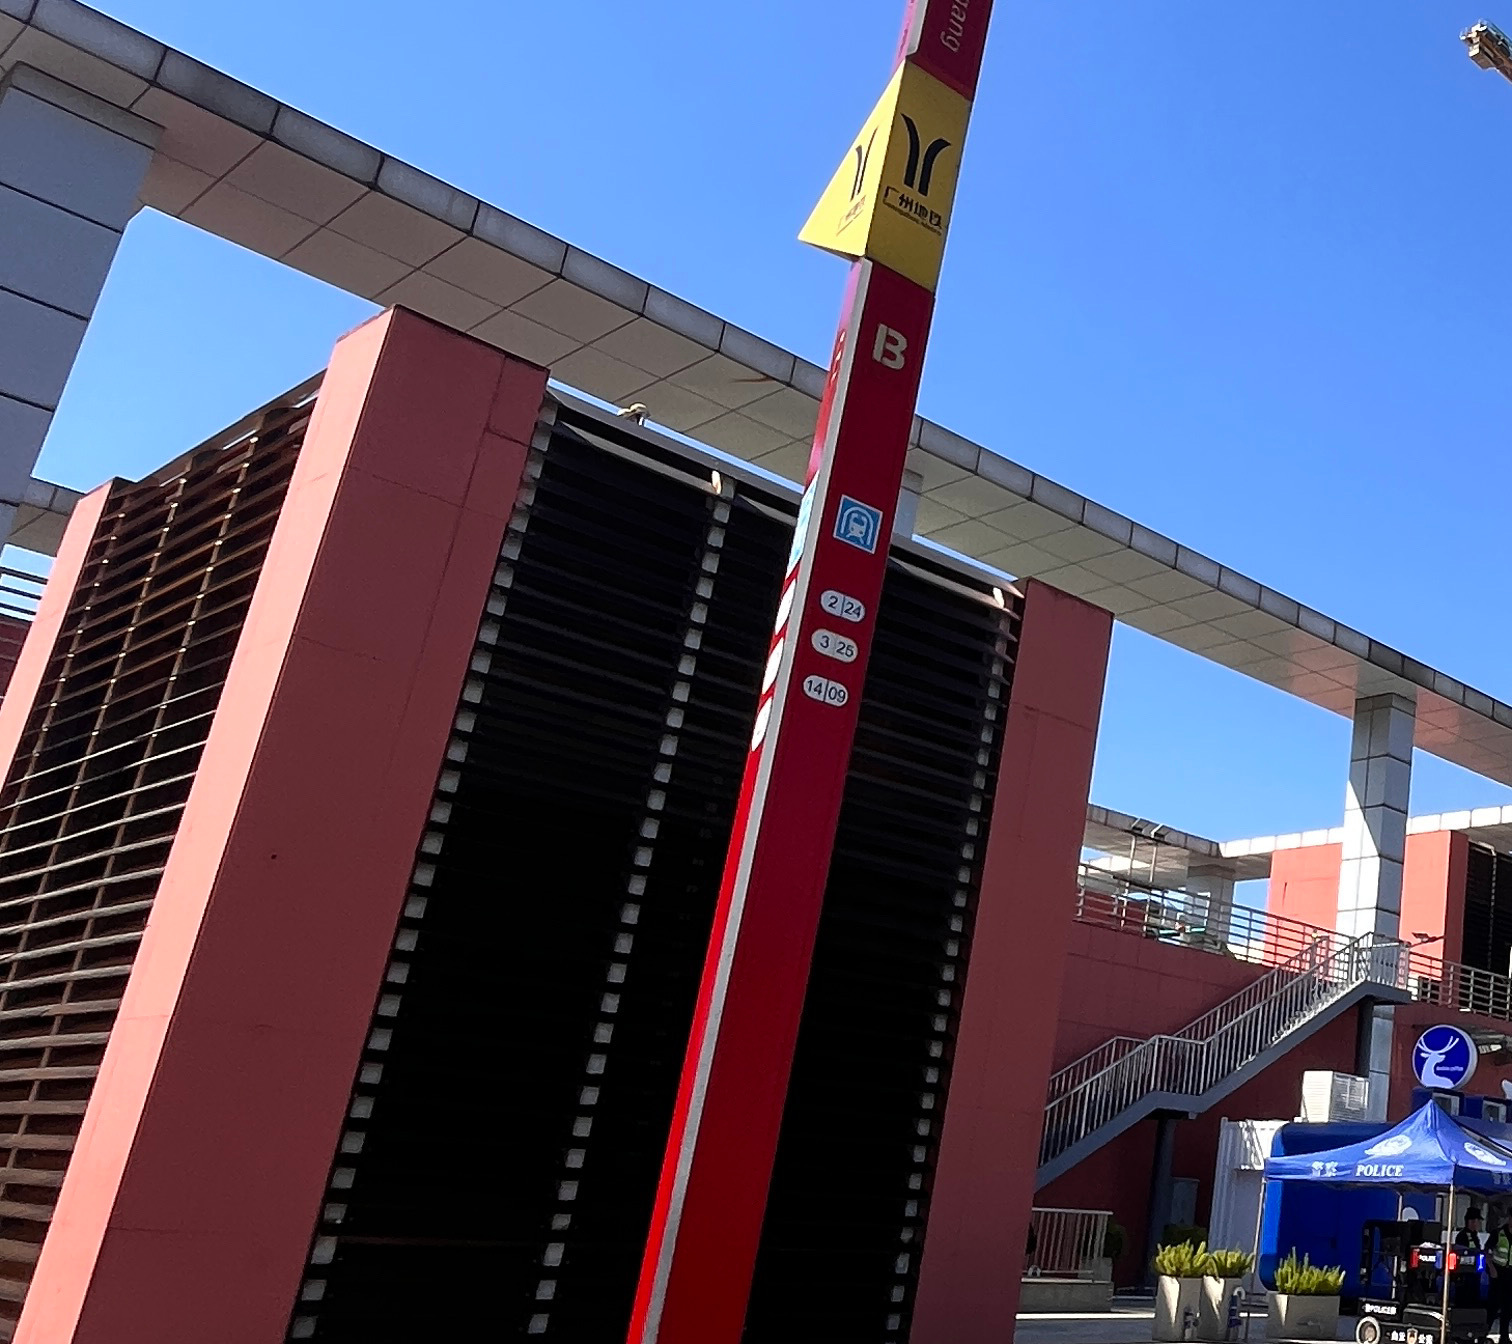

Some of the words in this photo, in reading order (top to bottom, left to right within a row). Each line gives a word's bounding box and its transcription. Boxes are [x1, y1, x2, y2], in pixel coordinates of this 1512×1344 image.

[872, 323, 907, 370] B
[827, 595, 839, 610] 2
[843, 601, 862, 619] 24
[819, 635, 830, 649] 3
[836, 641, 855, 658] 25
[806, 679, 823, 696] 14
[828, 686, 847, 704] 09
[1355, 1163, 1405, 1177] POLICE
